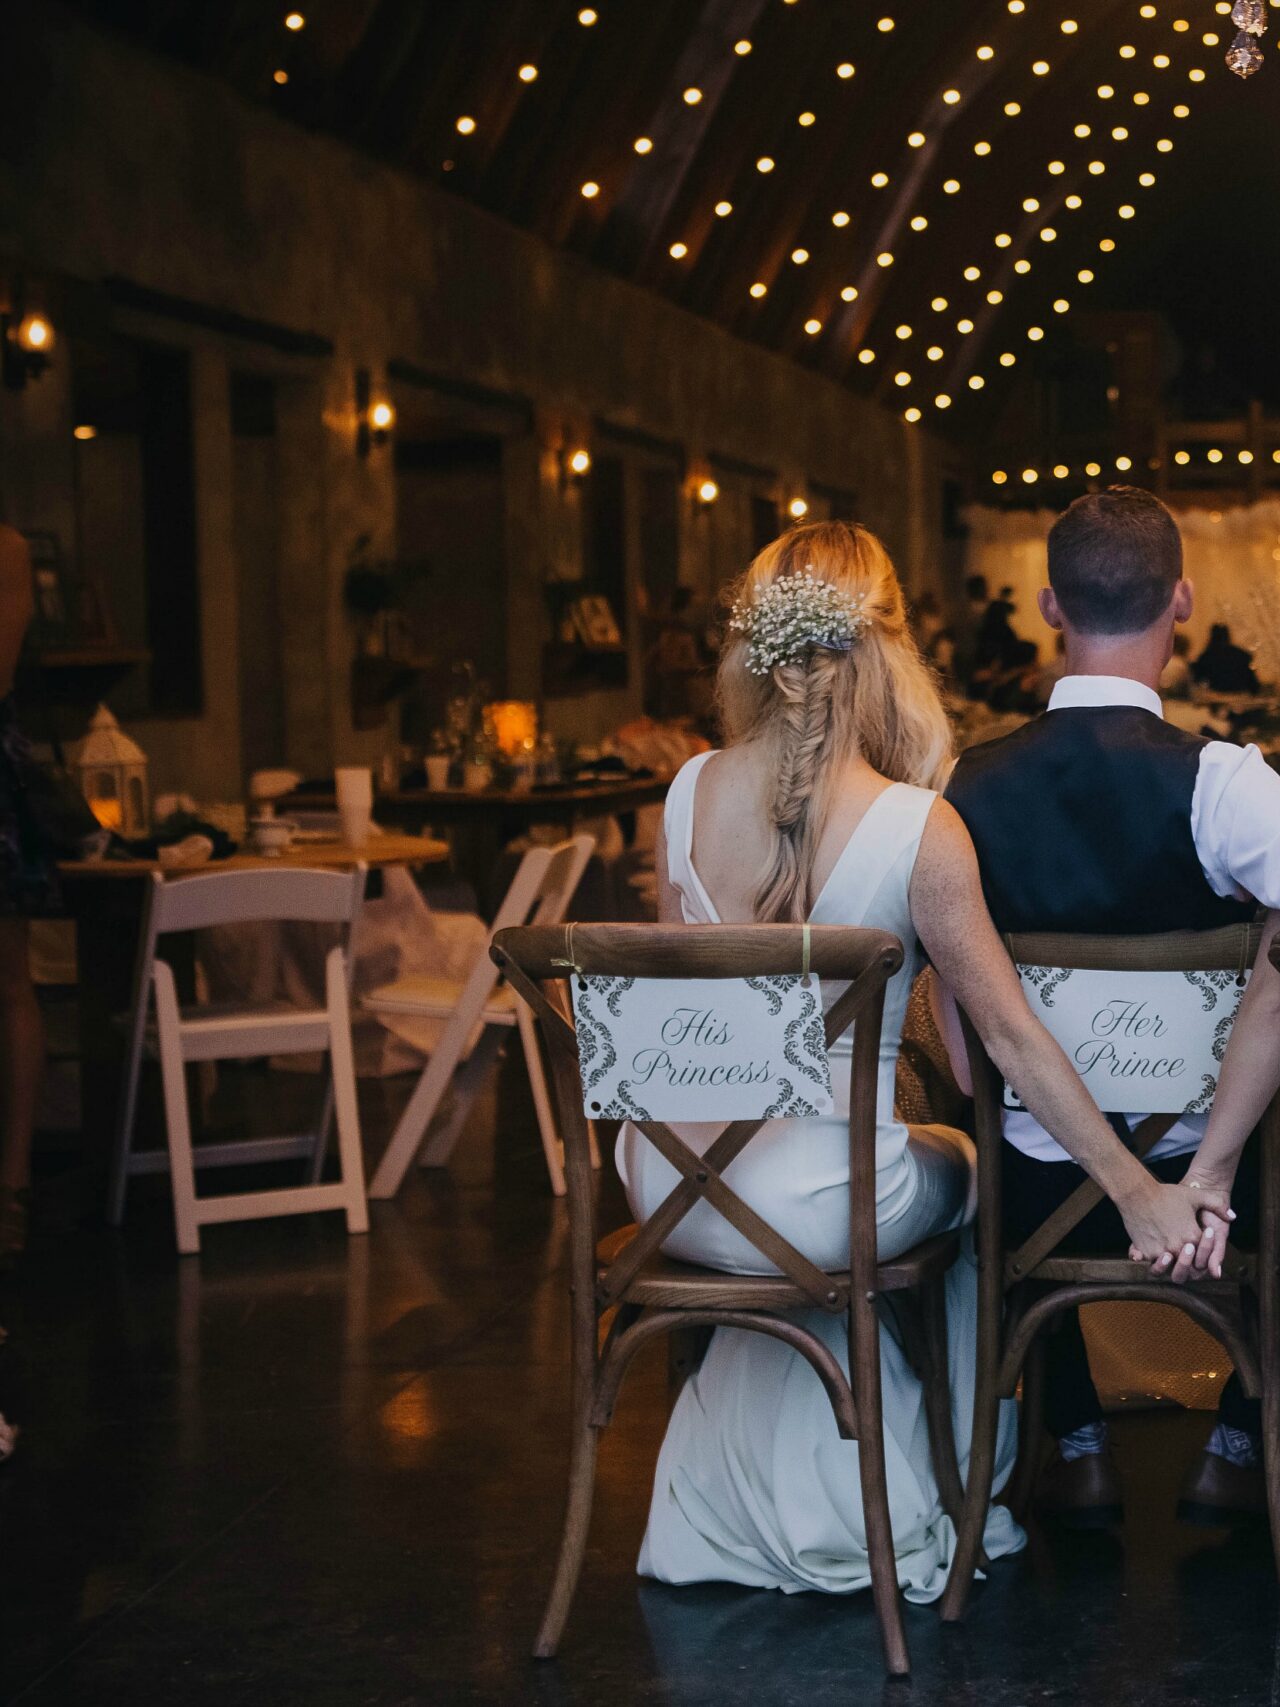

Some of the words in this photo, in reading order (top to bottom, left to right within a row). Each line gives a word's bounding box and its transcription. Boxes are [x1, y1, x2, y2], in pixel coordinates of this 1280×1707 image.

[661, 1008, 735, 1046] His
[1091, 1000, 1168, 1037] Her
[631, 1048, 776, 1086] Princess
[1074, 1039, 1186, 1078] Prince
